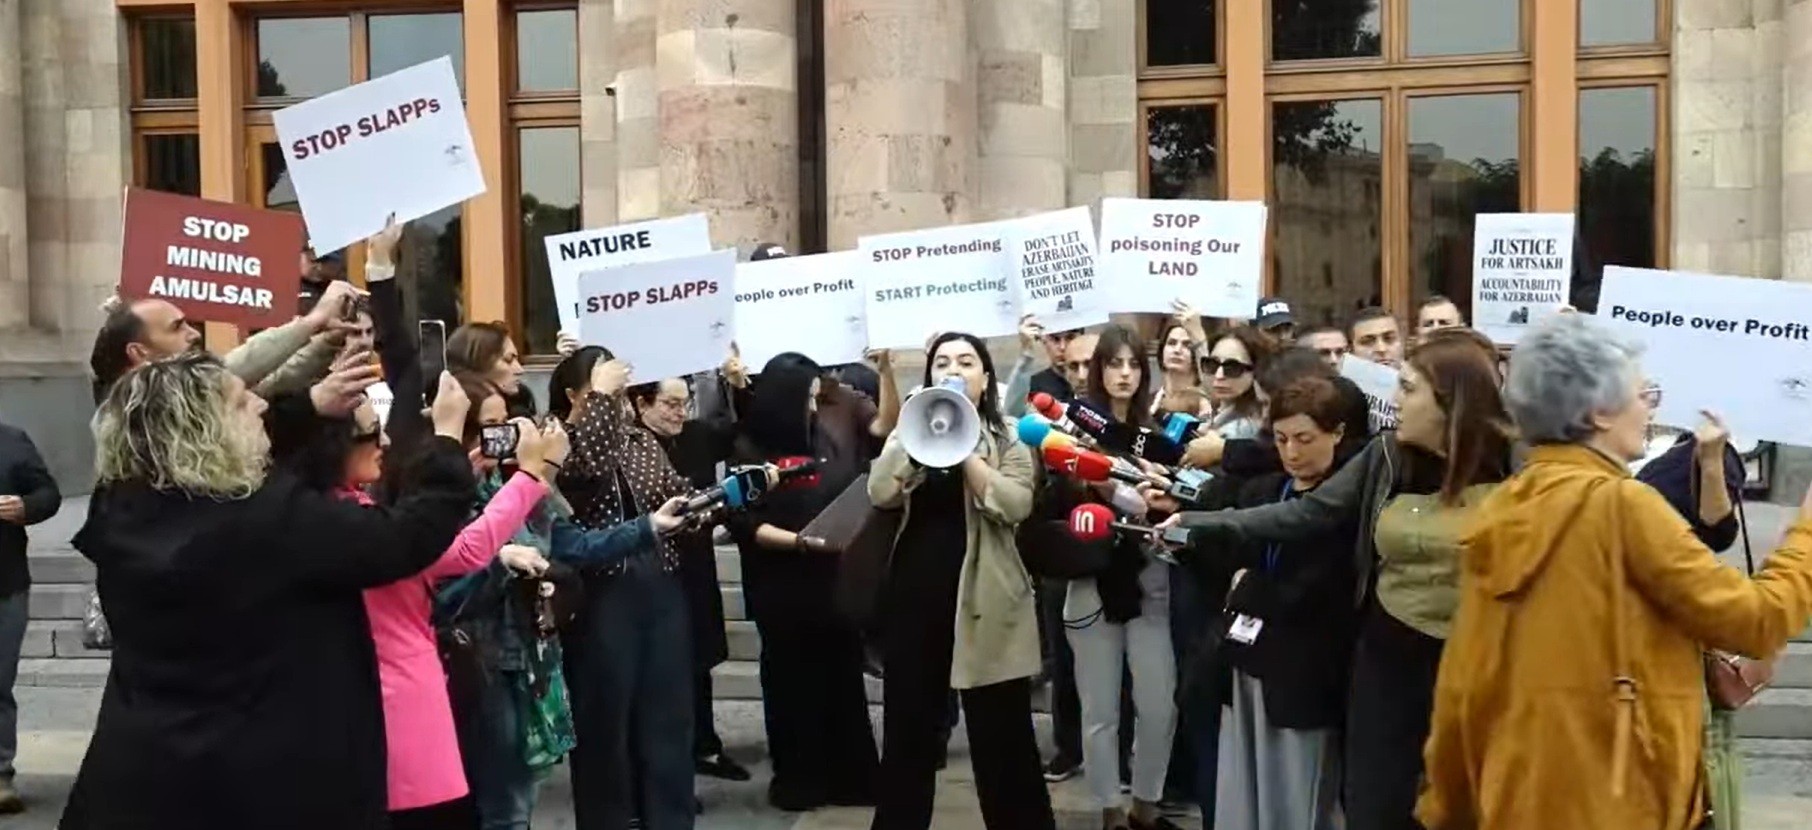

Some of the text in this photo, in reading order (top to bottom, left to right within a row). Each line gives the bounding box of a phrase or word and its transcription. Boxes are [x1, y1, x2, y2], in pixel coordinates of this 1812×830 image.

[292, 98, 441, 160] STOP SLAPPs
[183, 216, 250, 243] STOP
[1152, 213, 1201, 228] STOP
[559, 230, 652, 262] NATURE
[1060, 230, 1081, 246] LET
[1111, 236, 1241, 256] poisoning Our
[1488, 238, 1557, 256] JUSTICE
[167, 245, 262, 277] MINING
[872, 238, 1002, 262] STOP Pretending
[1022, 242, 1090, 268] AZERBAIJAN
[1021, 262, 1050, 279] ERASE
[1061, 266, 1096, 284] NATURE
[1148, 261, 1198, 277] LAND
[1481, 257, 1563, 270] FOR ARTSAKH
[149, 275, 274, 310] AMULSAR
[586, 290, 641, 313] STOP
[646, 279, 719, 305] SLAPPs
[734, 278, 855, 304] eople over Profit
[875, 277, 1008, 303] START Protecting
[1030, 278, 1093, 300] AND HERITAGE
[1480, 278, 1562, 292] ACCOUNTABILITY
[1480, 291, 1562, 304] FOR AZERBAIJAN
[1612, 305, 1810, 342] People over Profit
